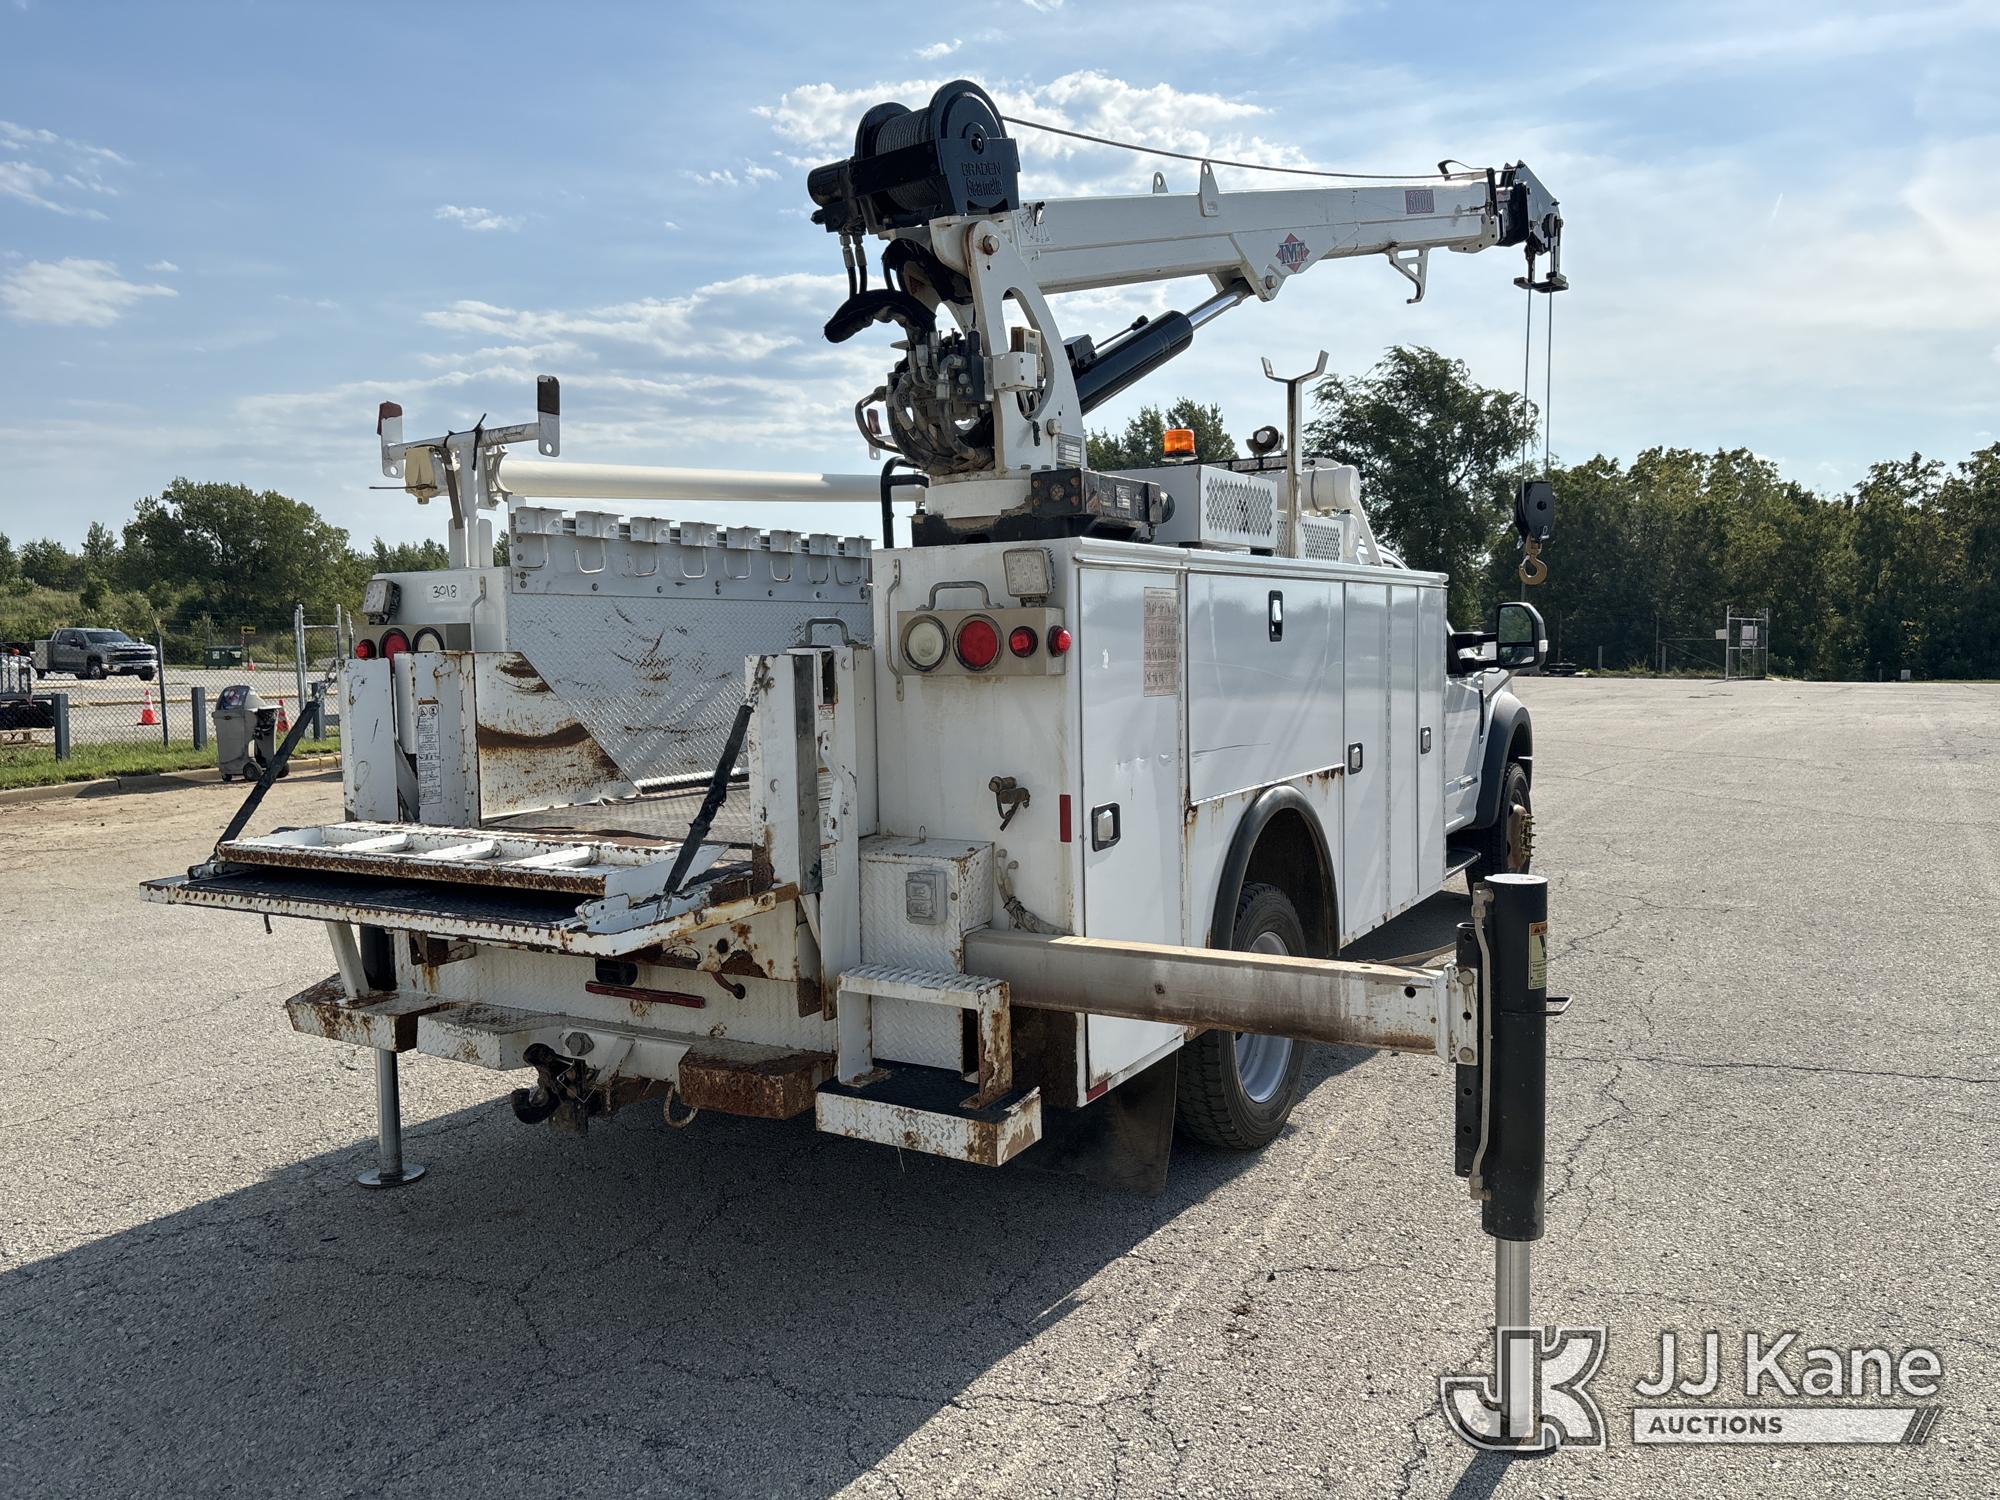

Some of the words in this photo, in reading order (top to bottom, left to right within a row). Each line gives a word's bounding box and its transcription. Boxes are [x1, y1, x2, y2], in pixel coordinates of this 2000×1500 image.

[961, 161, 1001, 176] BRADEN
[1407, 192, 1433, 213] 6000
[1279, 242, 1307, 265] IMT
[433, 585, 457, 598] 3018
